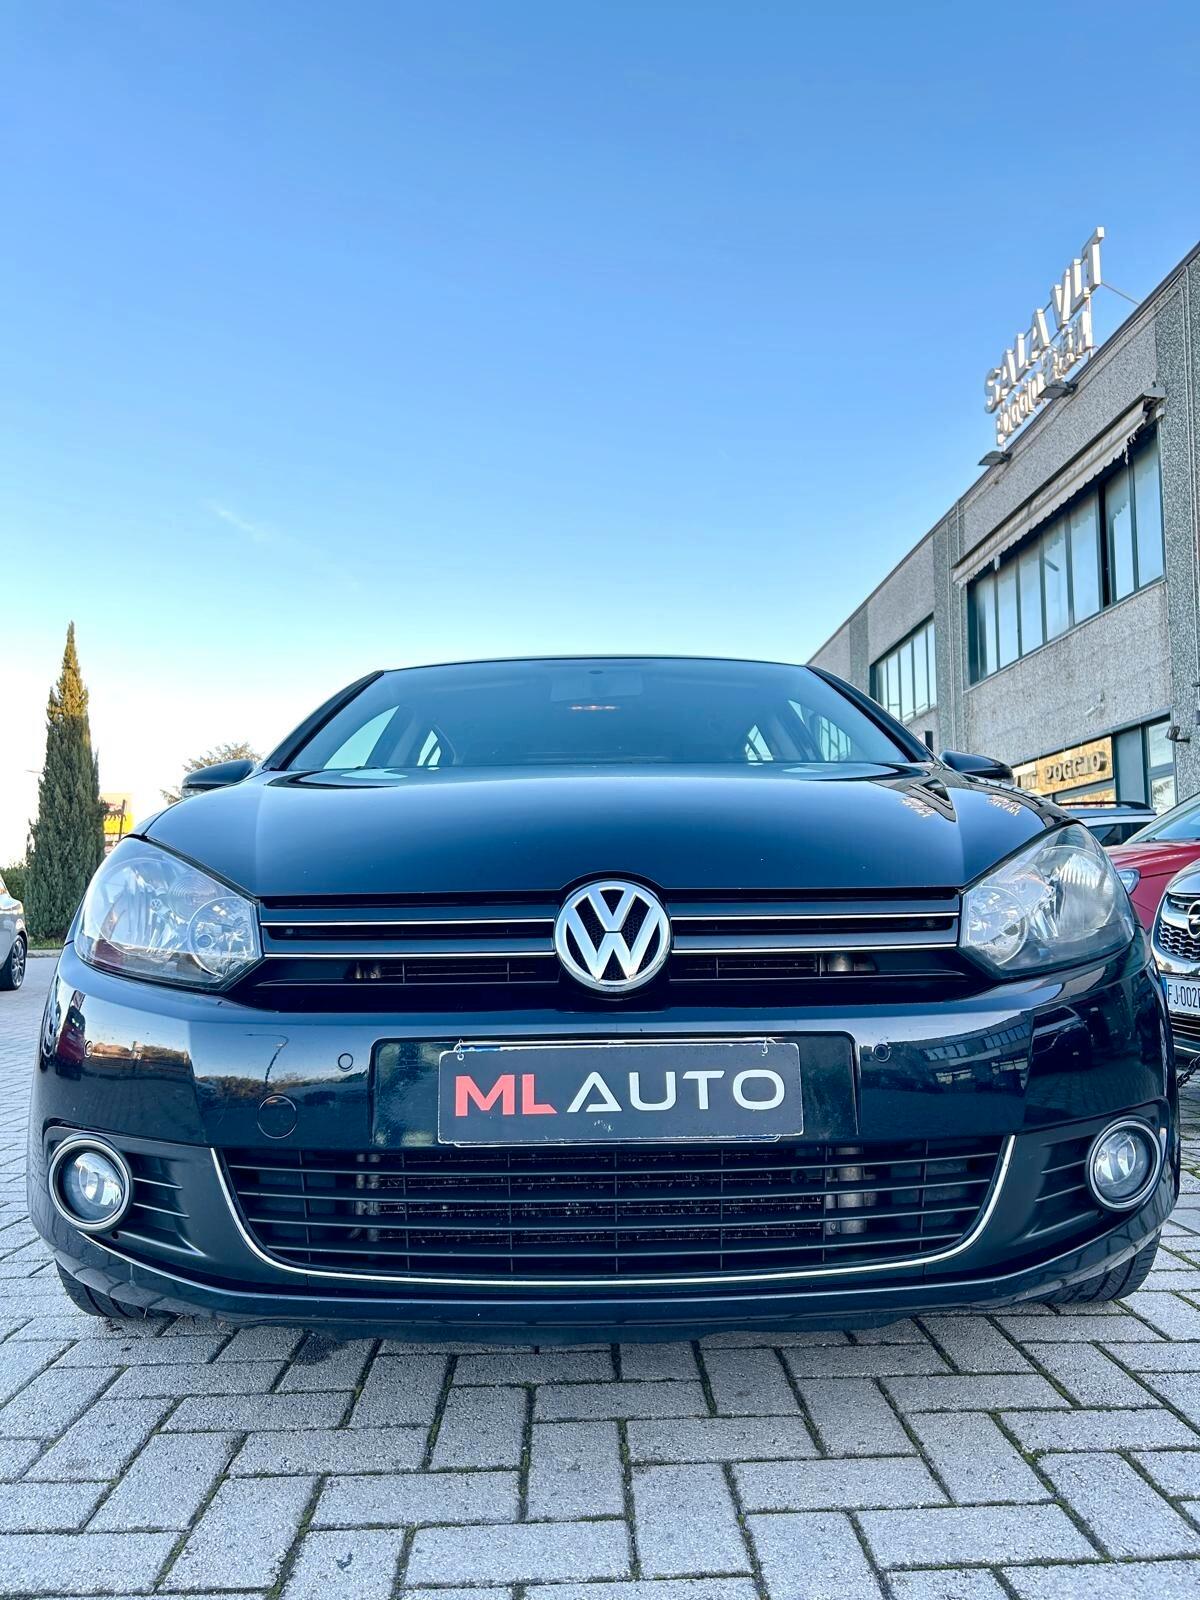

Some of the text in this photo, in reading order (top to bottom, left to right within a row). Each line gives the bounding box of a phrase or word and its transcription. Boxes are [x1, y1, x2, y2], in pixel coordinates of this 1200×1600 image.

[984, 307, 1051, 414] SALA
[1045, 750, 1108, 785] POGGIO
[559, 882, 667, 986] VW
[1167, 983, 1200, 1009] FJ002
[455, 1069, 786, 1117] ML AUTO
